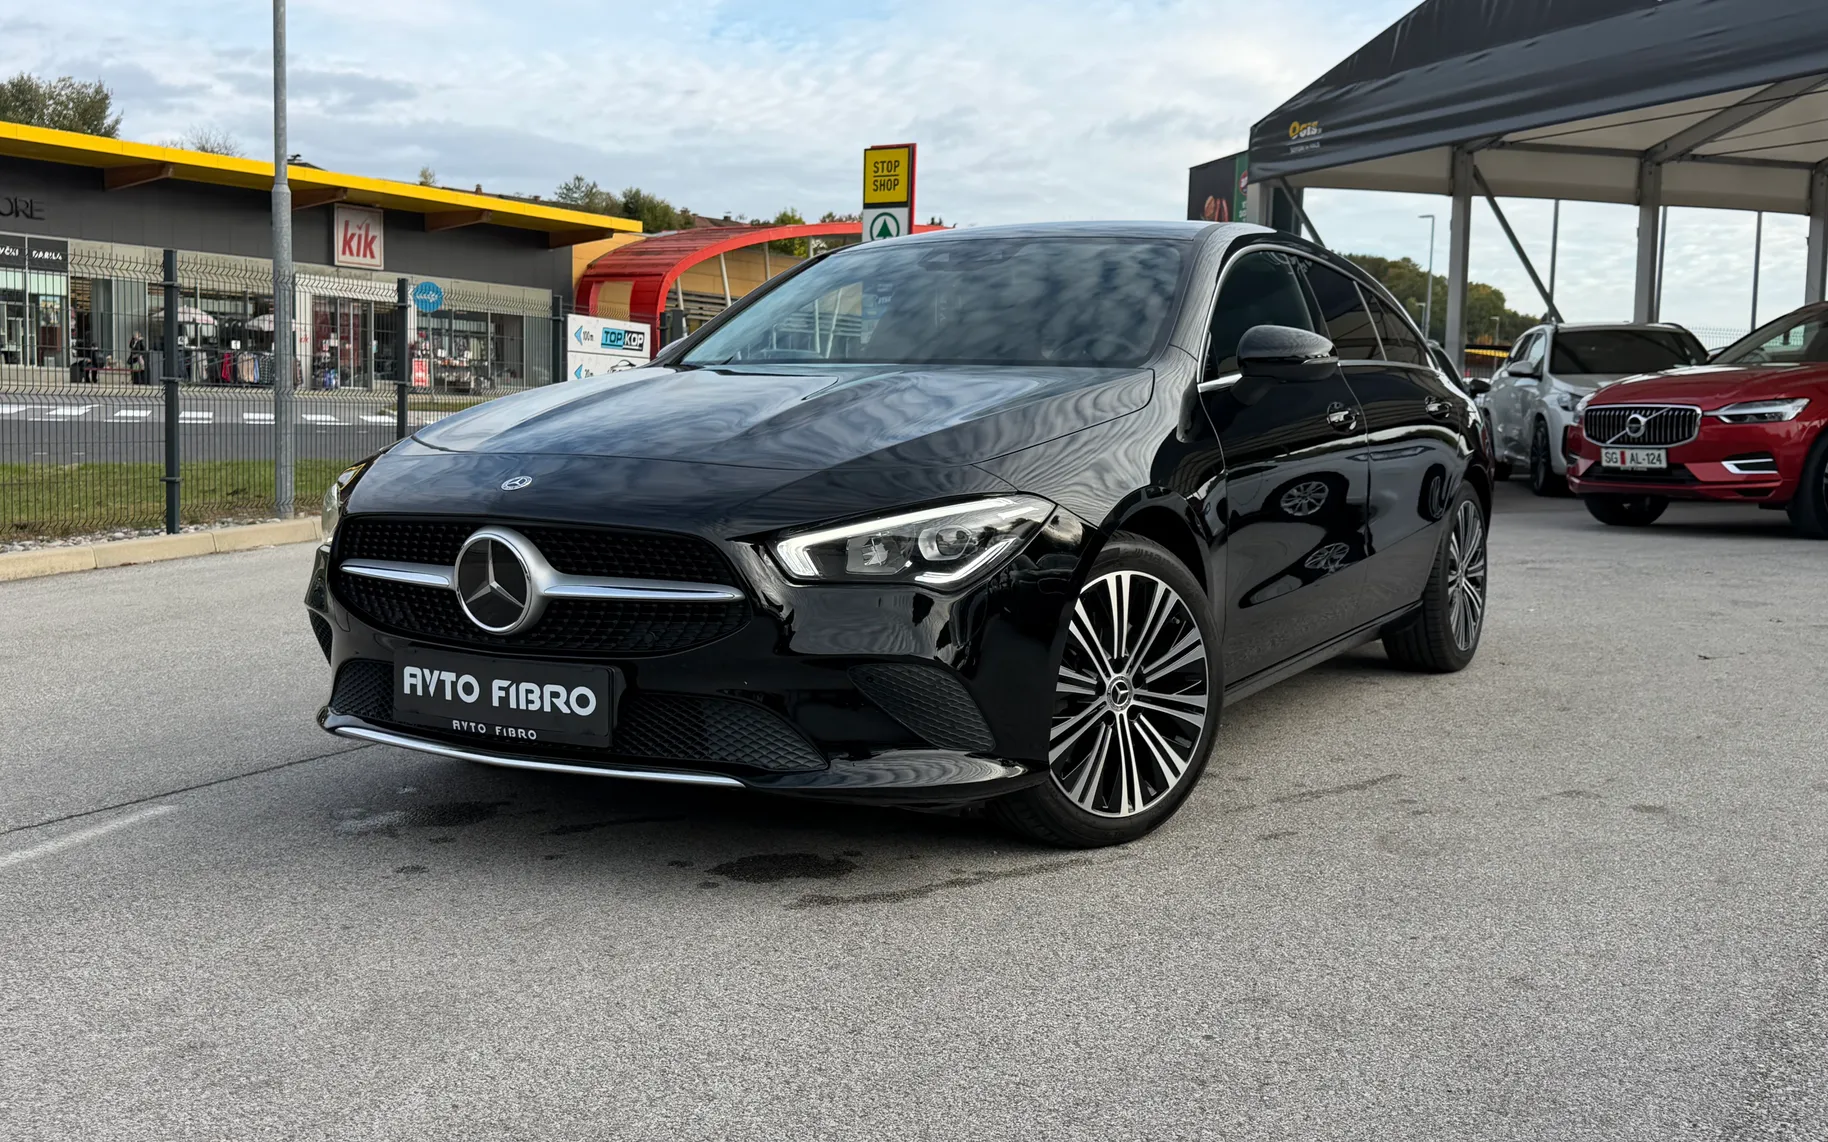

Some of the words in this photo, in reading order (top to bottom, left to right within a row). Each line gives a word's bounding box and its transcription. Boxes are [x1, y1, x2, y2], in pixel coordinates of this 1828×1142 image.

[873, 160, 900, 174] STOP
[872, 178, 899, 192] SHOP
[1605, 451, 1618, 464] SG
[1630, 452, 1662, 465] AL-124
[403, 666, 480, 703] AVTO
[492, 679, 597, 716] FIBRO
[452, 720, 486, 734] AVTO
[495, 726, 537, 740] FIBRO
